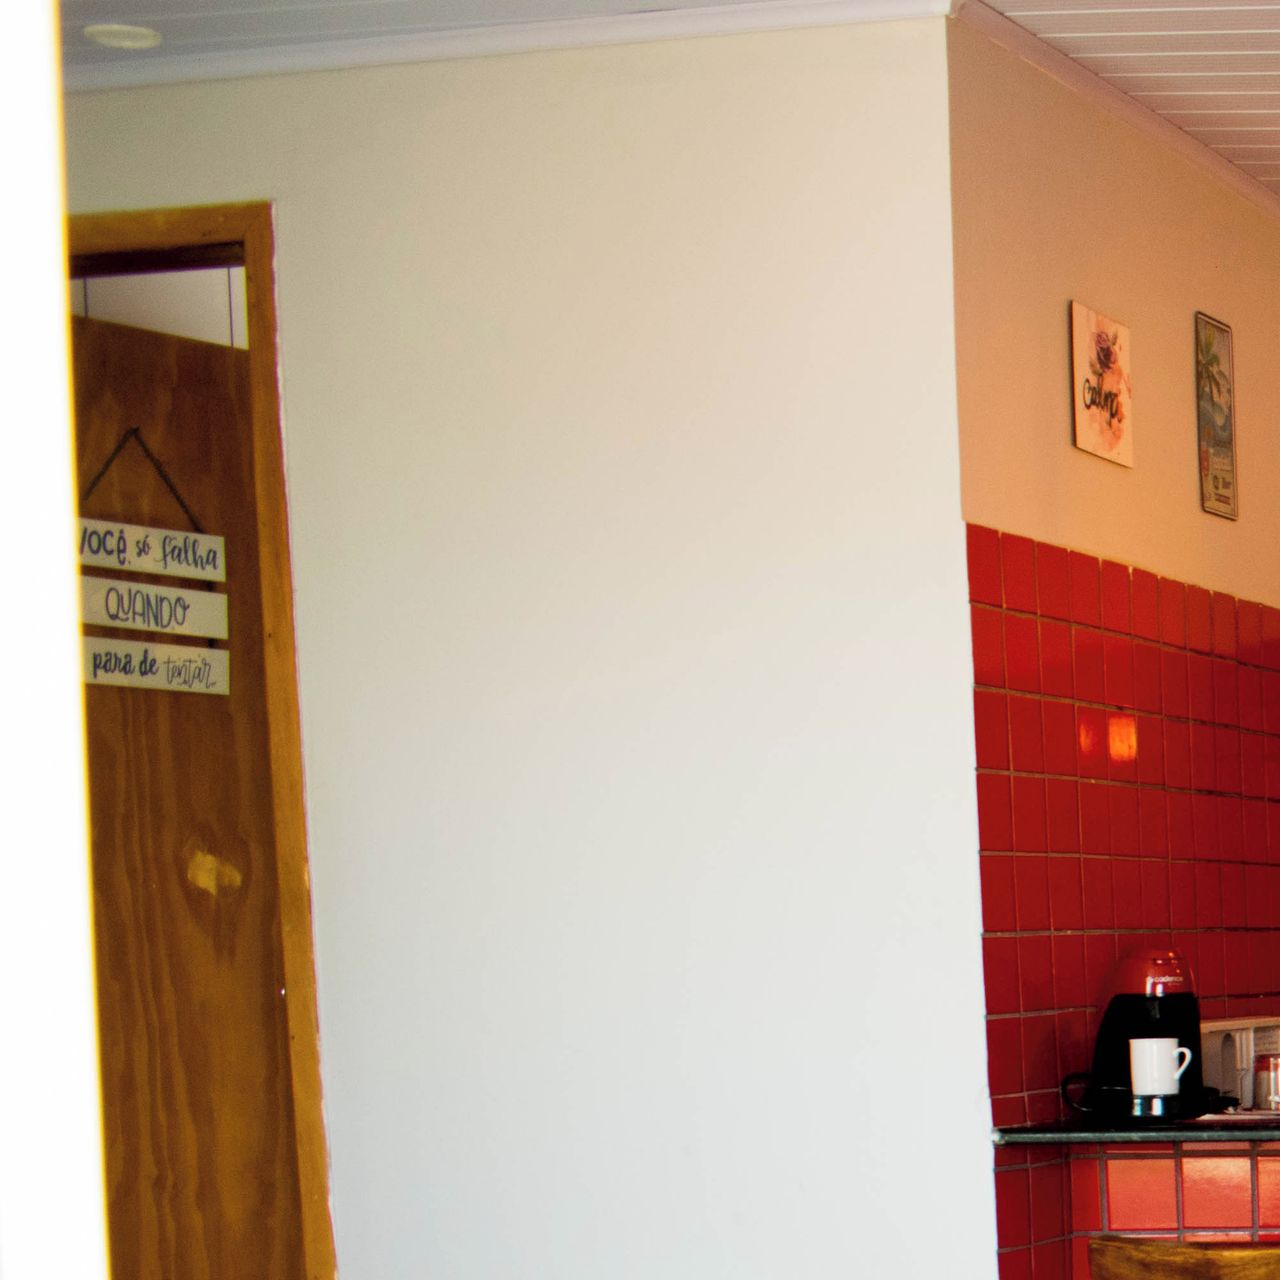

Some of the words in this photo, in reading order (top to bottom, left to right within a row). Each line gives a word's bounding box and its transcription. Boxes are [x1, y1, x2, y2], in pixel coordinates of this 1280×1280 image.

[136, 534, 152, 558] só
[155, 534, 219, 571] falha
[105, 587, 190, 629] QUANDO
[92, 650, 135, 679] para
[138, 648, 159, 677] de
